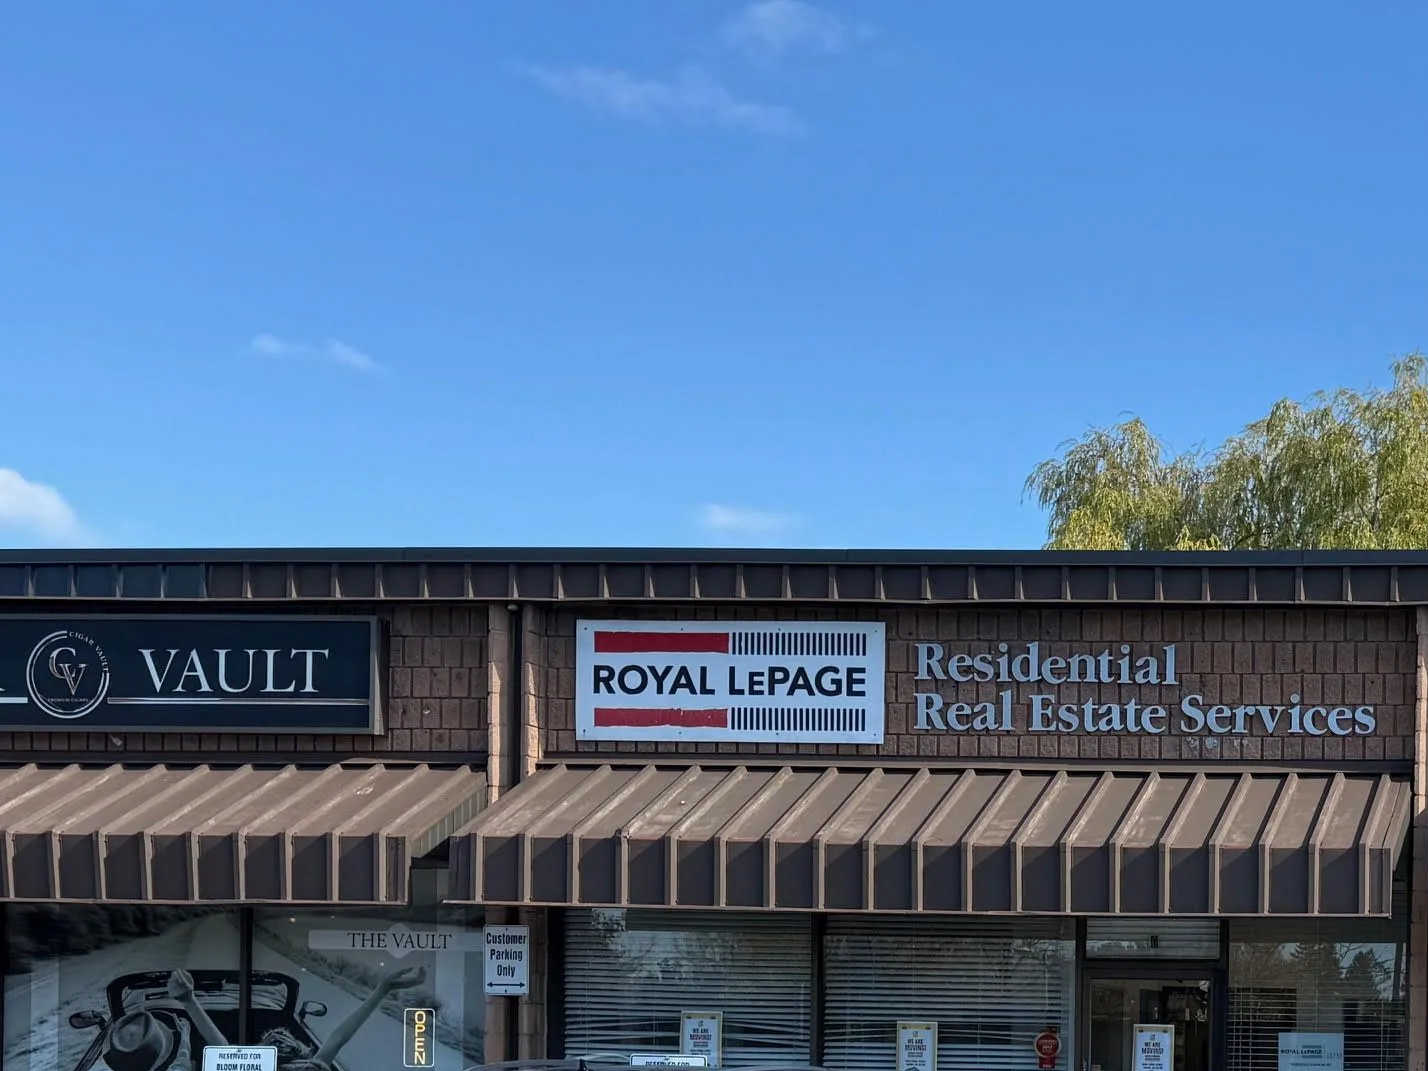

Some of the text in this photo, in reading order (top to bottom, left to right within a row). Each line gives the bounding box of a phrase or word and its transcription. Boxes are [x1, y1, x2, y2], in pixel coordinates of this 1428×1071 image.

[138, 648, 329, 693] VAULT
[914, 642, 1179, 686] Residential
[593, 664, 716, 695] ROYAL
[913, 691, 1377, 735] Real Estate Services
[347, 932, 452, 949] THE VAULT
[486, 932, 526, 944] Customer
[490, 948, 523, 961] Parking
[496, 964, 516, 977] Only
[414, 1011, 426, 1064] OPEN
[216, 1063, 238, 1071] BLOOM
